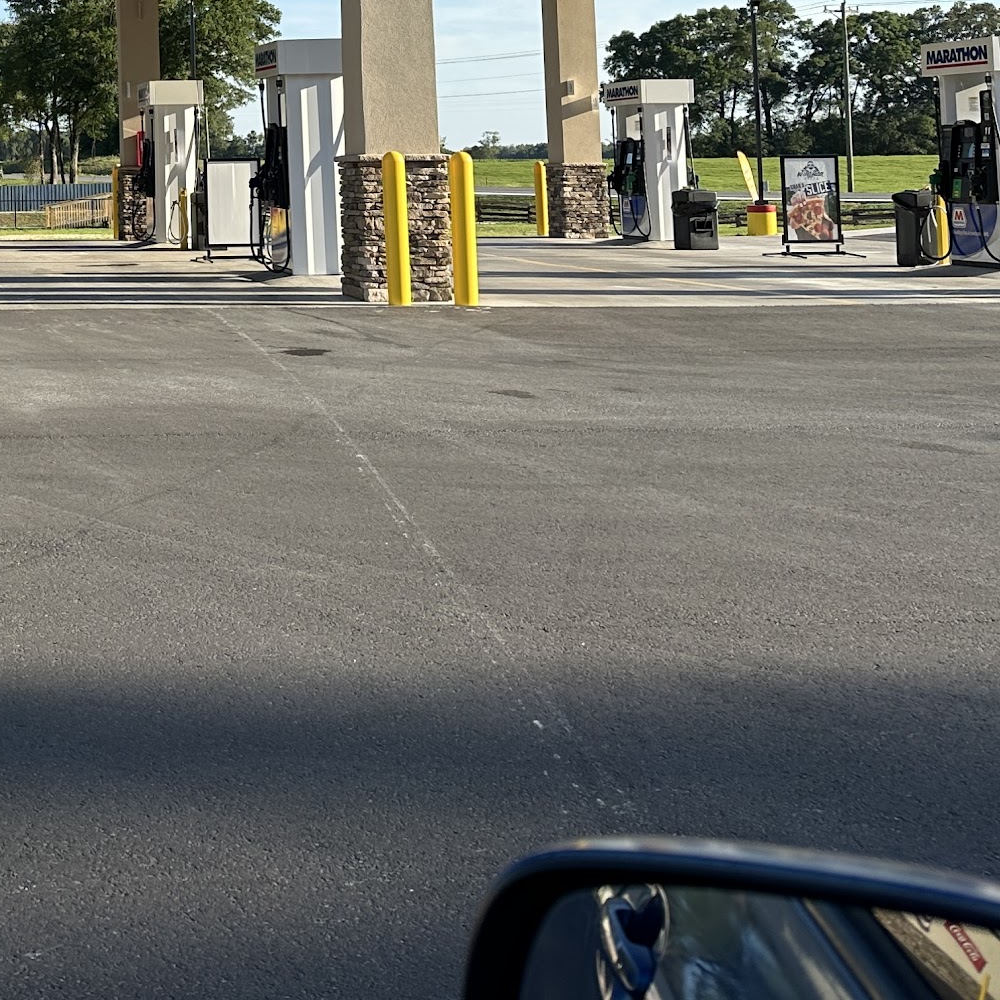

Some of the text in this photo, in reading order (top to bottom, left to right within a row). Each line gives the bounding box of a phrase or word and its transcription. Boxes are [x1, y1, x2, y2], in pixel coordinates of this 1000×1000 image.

[926, 45, 987, 65] MARATHON
[606, 86, 639, 99] MARATHON
[805, 182, 830, 196] SLICE
[954, 210, 964, 221] M
